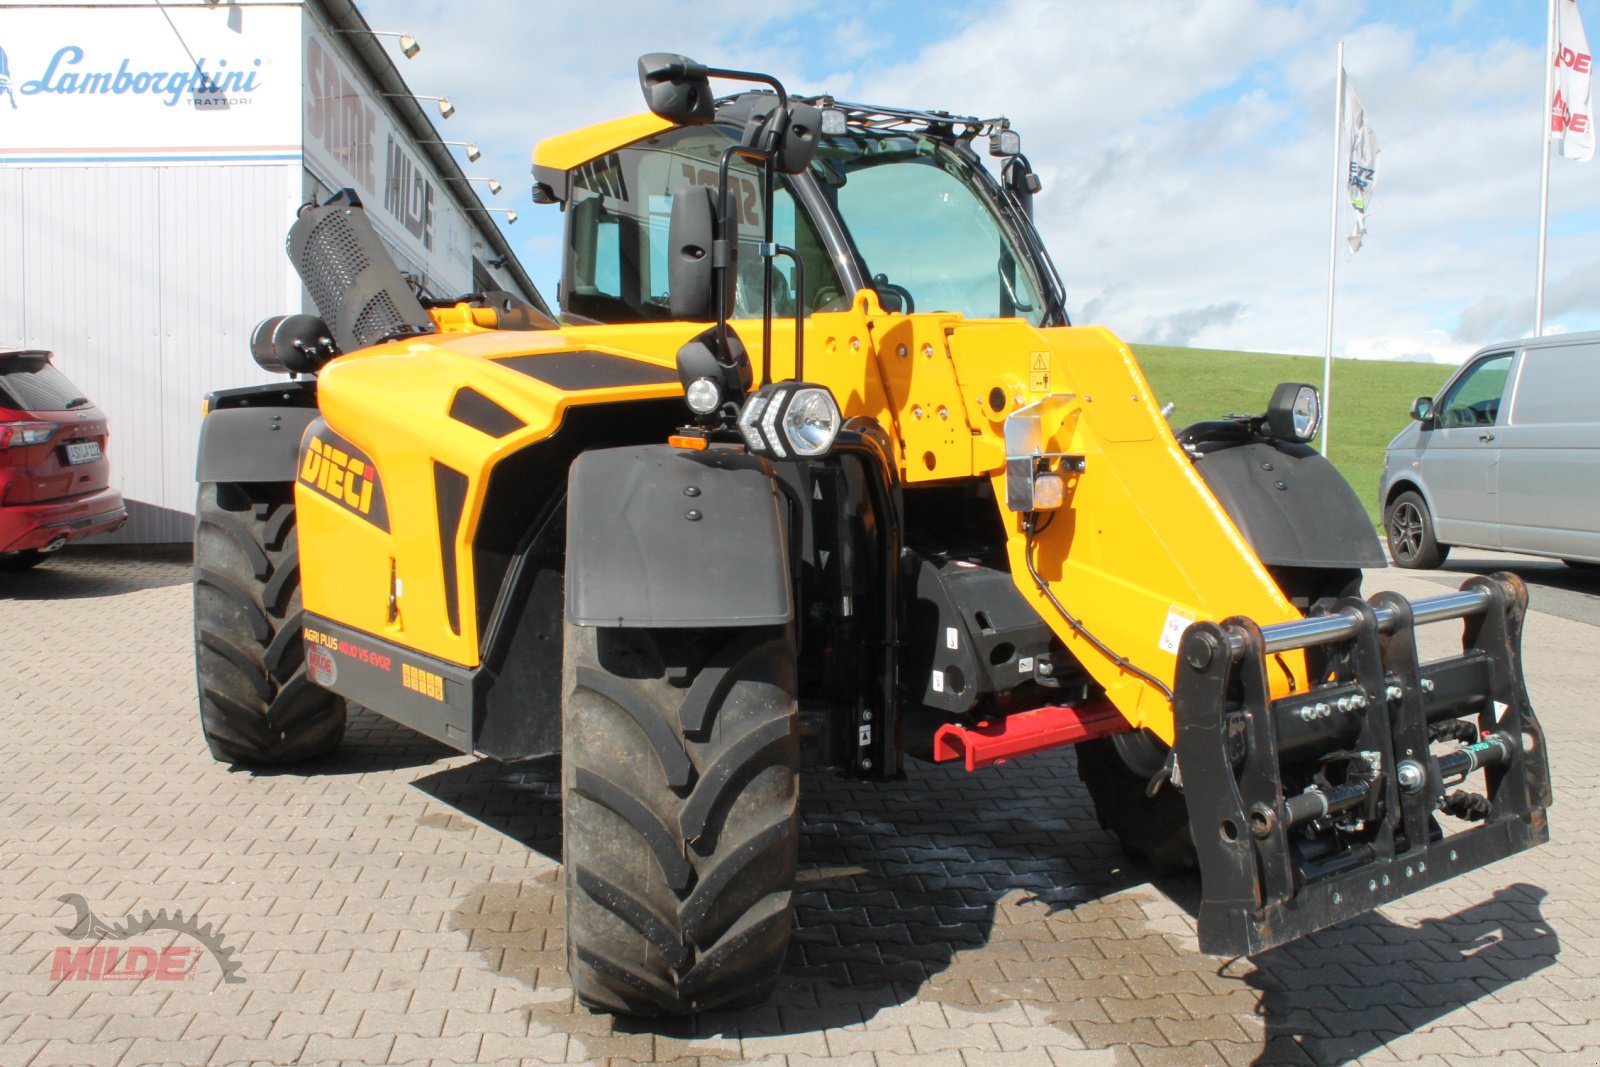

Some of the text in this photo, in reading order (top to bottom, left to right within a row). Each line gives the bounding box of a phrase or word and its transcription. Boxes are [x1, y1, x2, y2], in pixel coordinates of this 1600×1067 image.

[20, 46, 262, 107] Lamborghini
[187, 98, 252, 107] TRATTORI
[384, 132, 436, 253] MILDE
[304, 628, 319, 643] AGRI
[320, 634, 337, 650] PLUS
